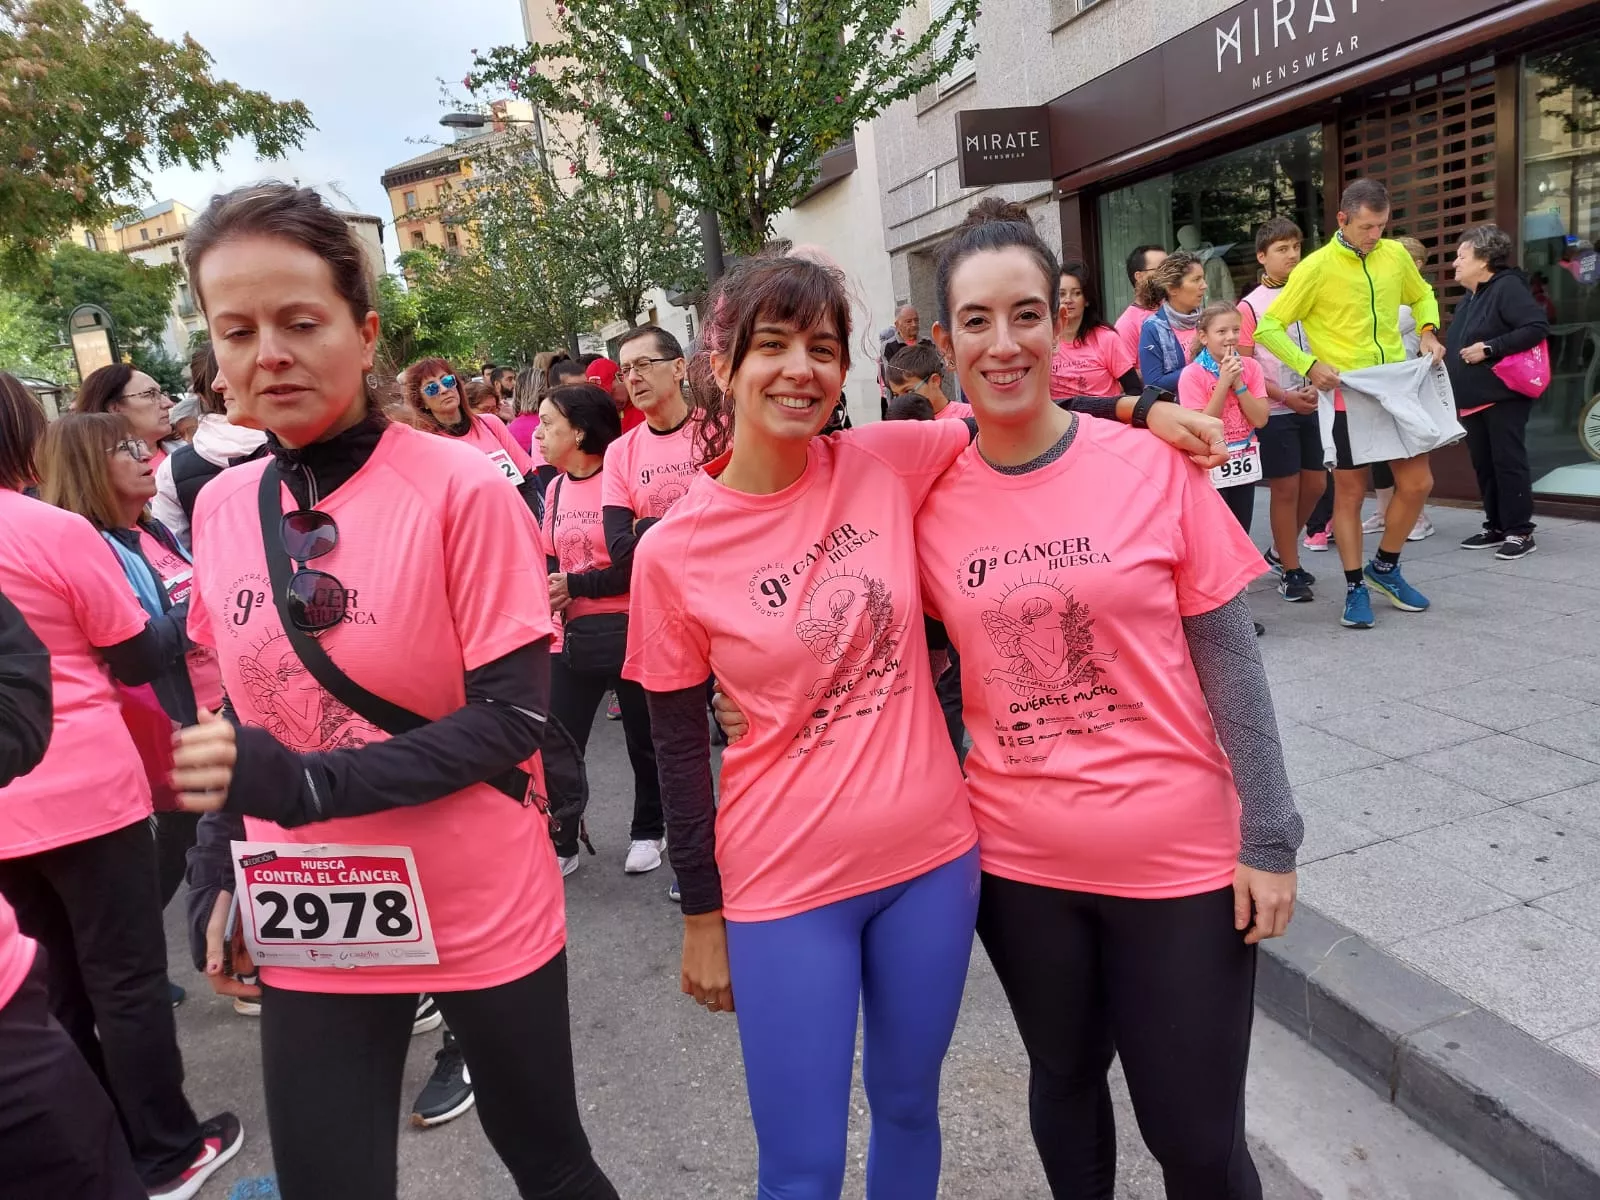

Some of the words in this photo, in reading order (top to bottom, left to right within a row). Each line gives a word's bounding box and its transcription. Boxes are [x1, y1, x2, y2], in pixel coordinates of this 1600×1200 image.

[1216, 0, 1384, 72] MIRA
[1252, 35, 1359, 90] MENSWEAR
[966, 131, 1040, 152] MIRATE
[983, 152, 1025, 160] MENSWEAR
[1221, 457, 1252, 478] 936
[566, 509, 599, 519] CÁNCER
[828, 529, 879, 565] HUESCA
[1003, 536, 1092, 565] CÁNCER
[1048, 552, 1111, 571] HUESCA
[867, 658, 902, 679] MUCH
[1009, 693, 1070, 714] QUIÉRETE
[1073, 684, 1118, 703] MUCHO
[300, 859, 346, 870] HUESCA
[253, 869, 313, 884] CONTRA
[317, 872, 336, 884] EL
[338, 867, 402, 883] CÁNCER
[254, 889, 413, 940] 2978
